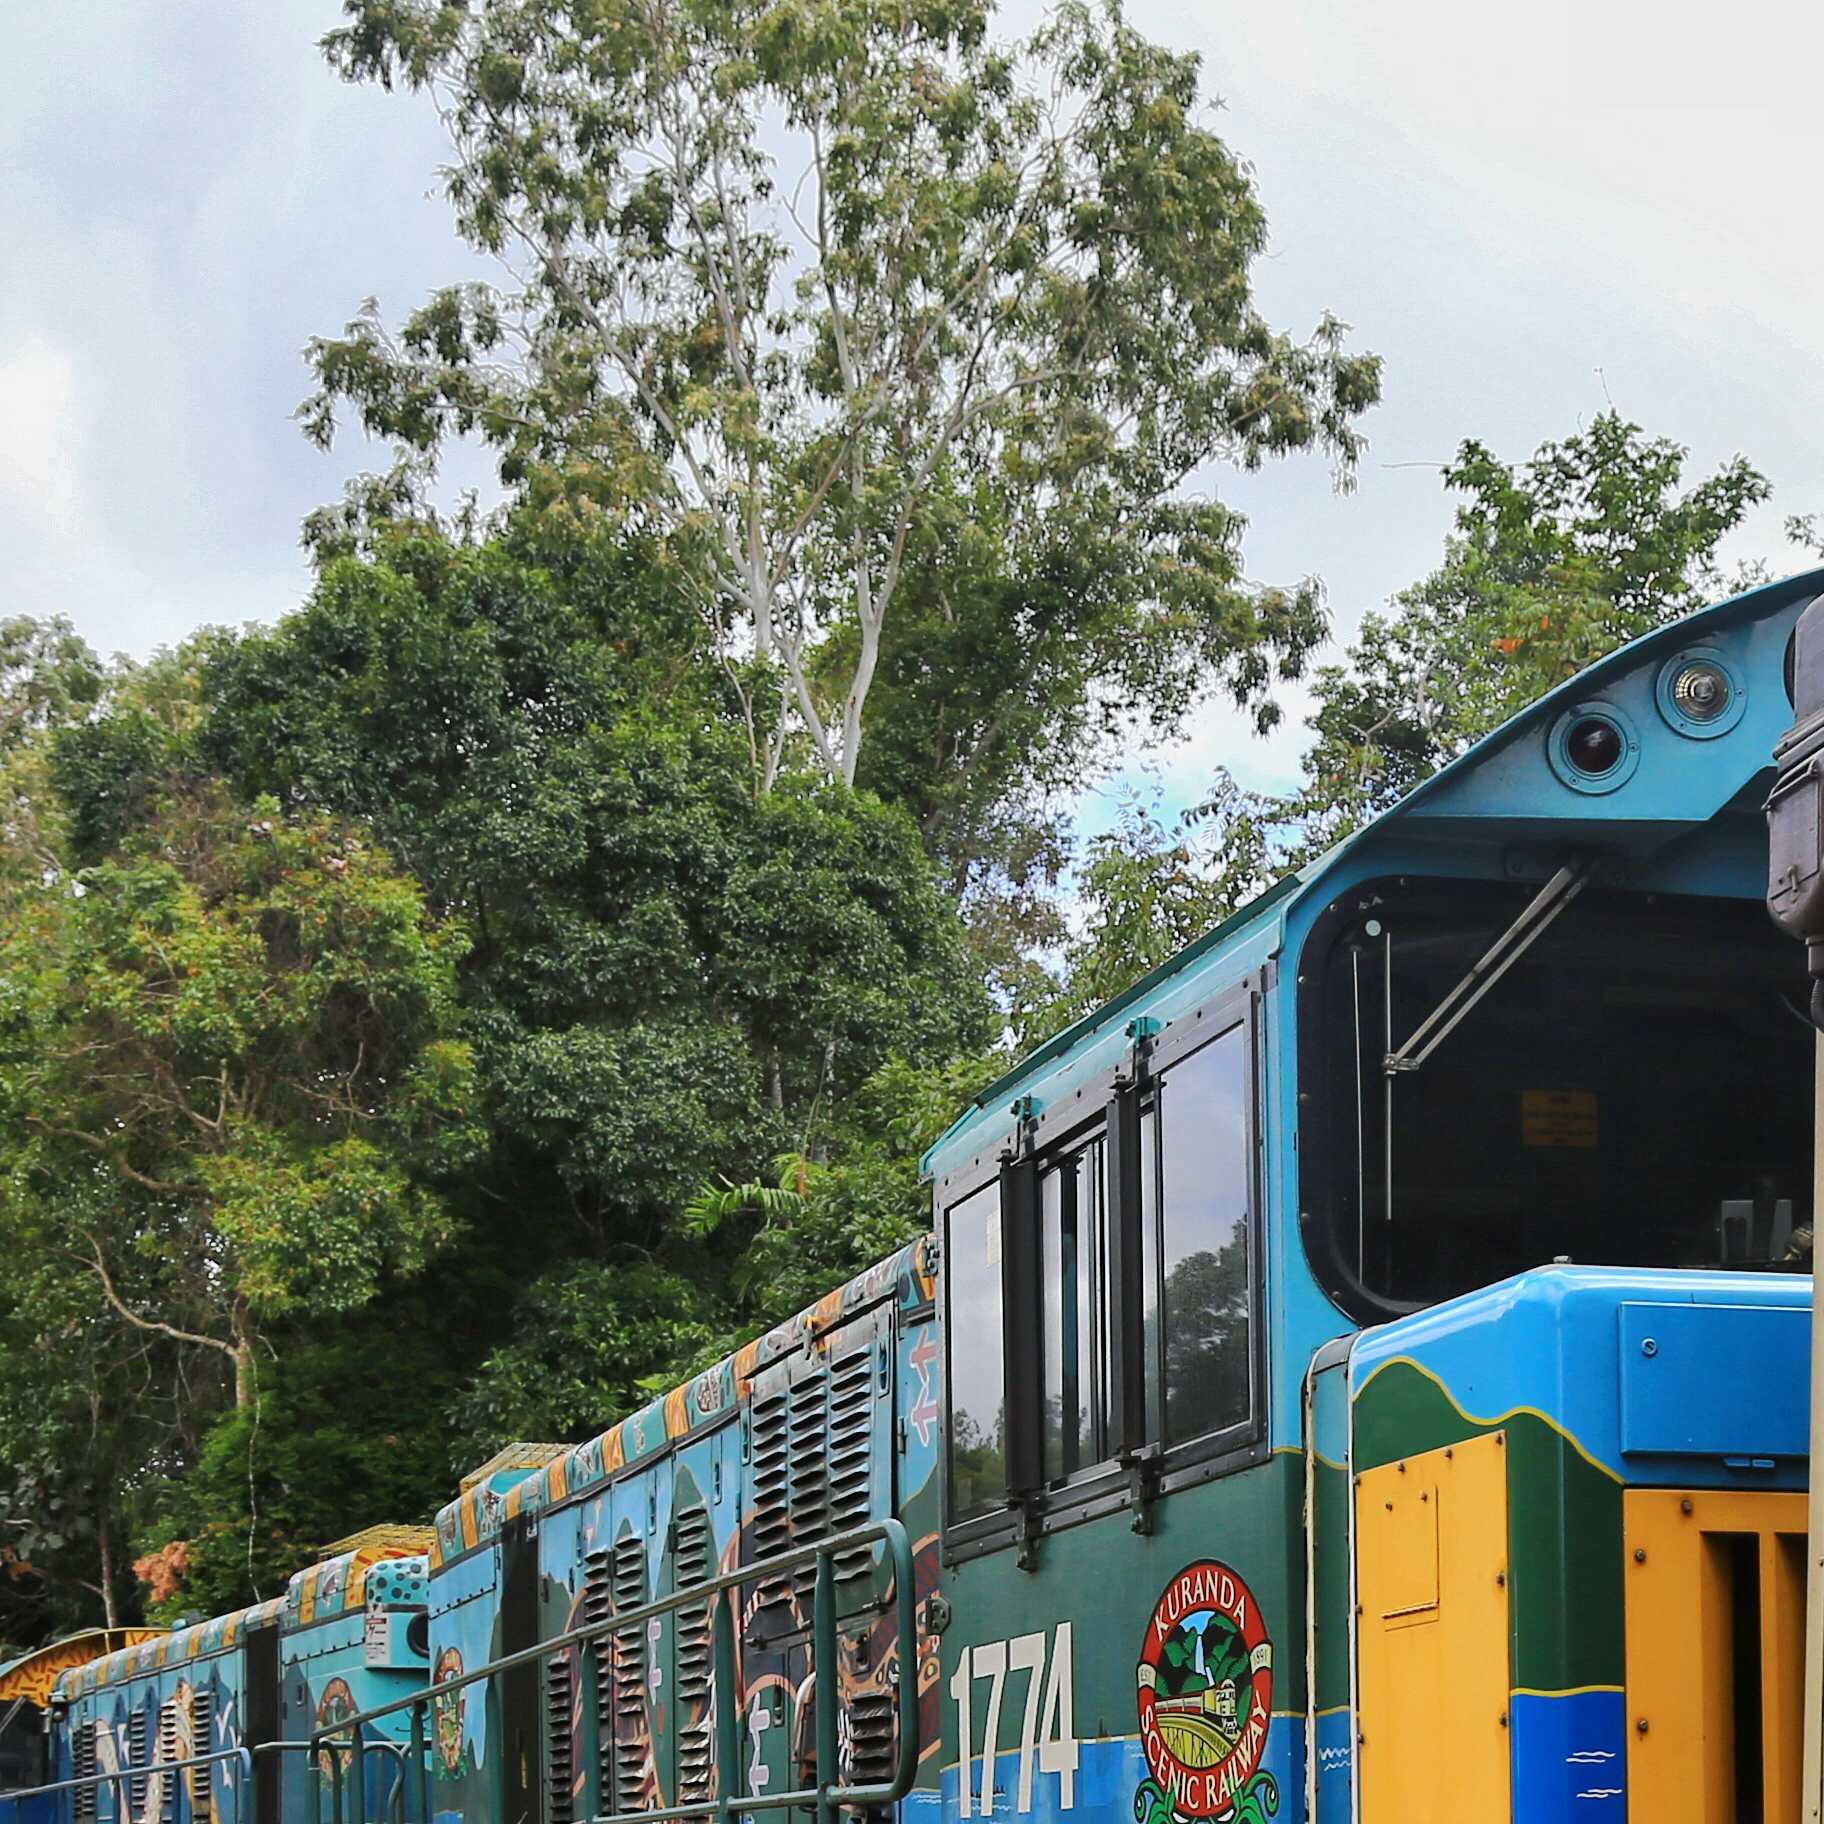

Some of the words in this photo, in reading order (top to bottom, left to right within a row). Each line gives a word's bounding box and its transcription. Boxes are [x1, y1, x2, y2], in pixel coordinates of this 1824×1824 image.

[1154, 1569, 1247, 1642] KURANDA
[949, 1621, 1079, 1819] 1774
[1140, 1704, 1200, 1809] SCENIC
[1206, 1689, 1267, 1809] RAILWAY
